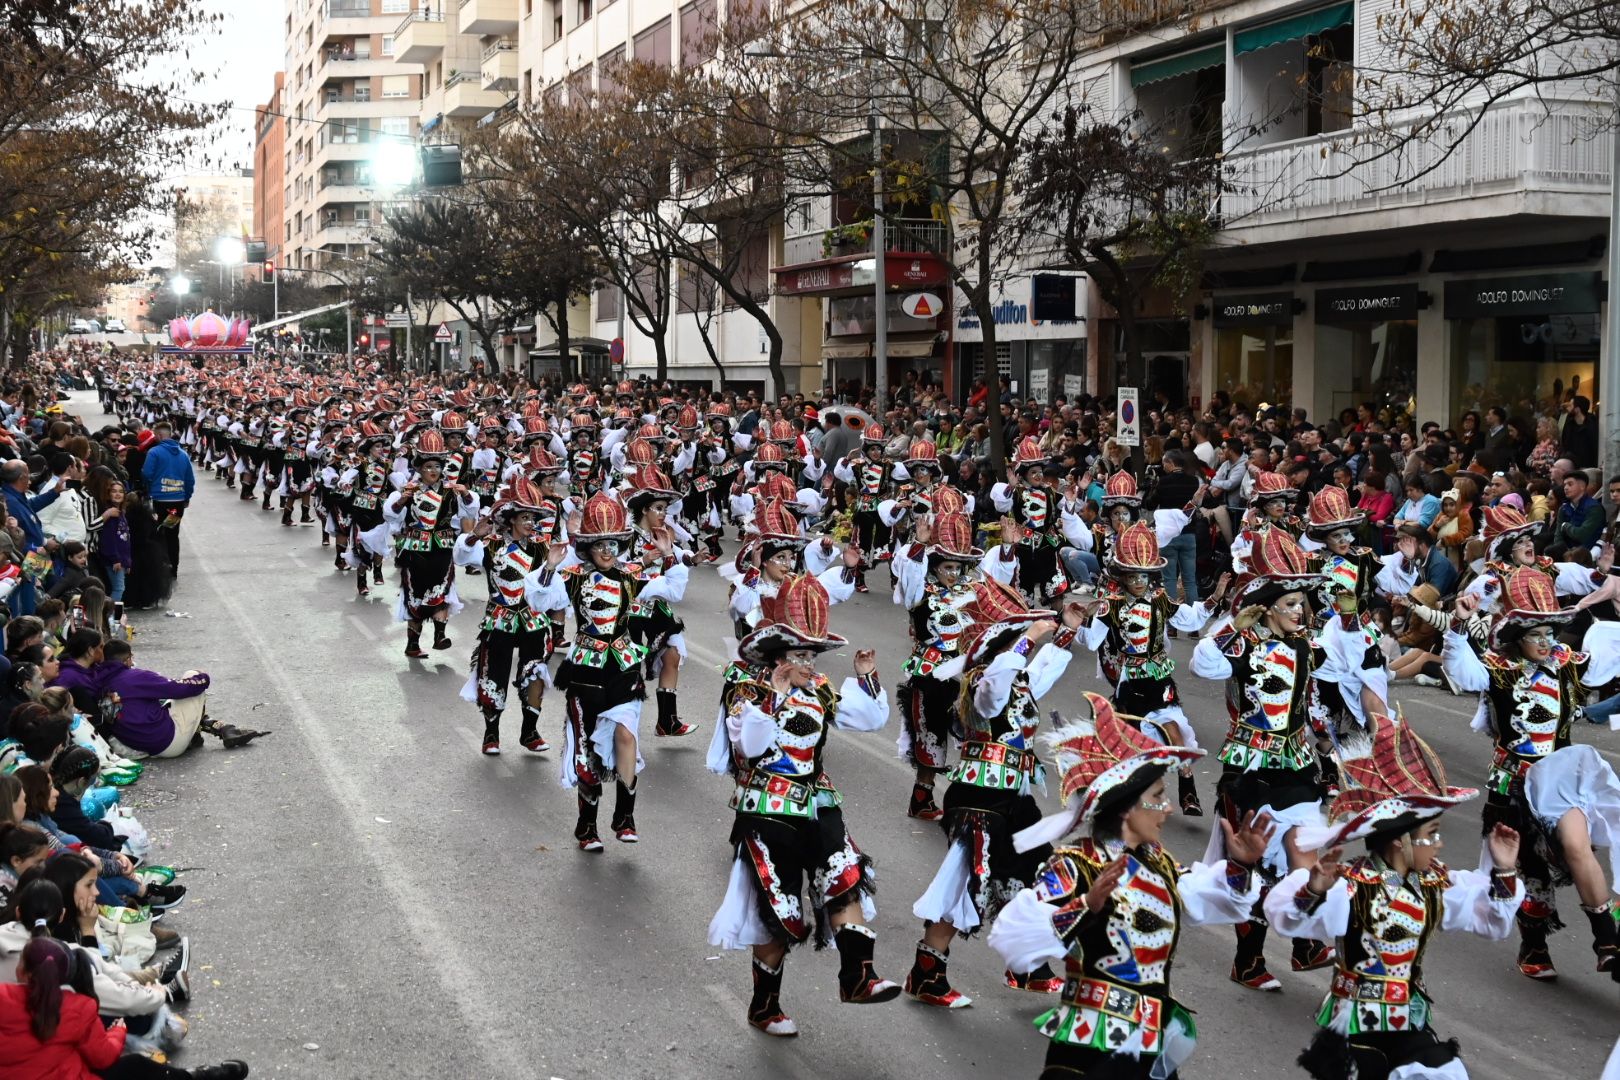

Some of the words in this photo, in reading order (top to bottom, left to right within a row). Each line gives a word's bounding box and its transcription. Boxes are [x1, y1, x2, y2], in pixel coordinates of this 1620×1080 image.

[1331, 299, 1356, 311] ADOLFO
[1358, 296, 1401, 310] DOMINGUEZ
[1477, 291, 1508, 304] ADOLFO
[1511, 287, 1564, 303] DOMINGUEZ
[992, 300, 1027, 325] udifon
[1224, 305, 1245, 316] ADOLFO
